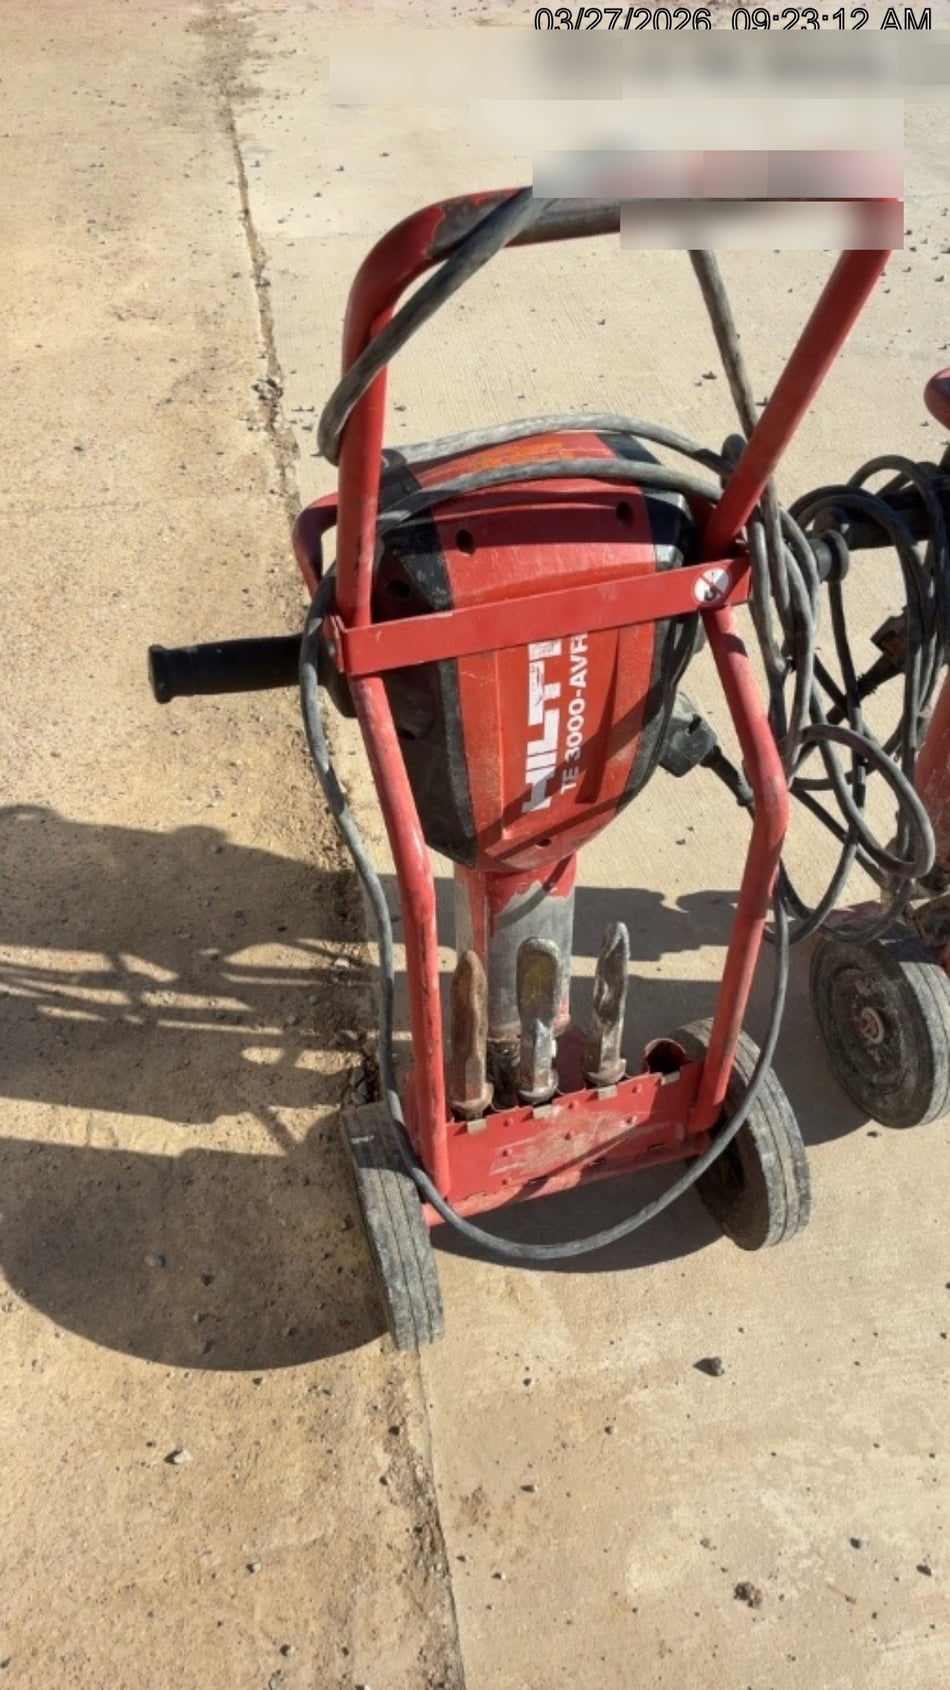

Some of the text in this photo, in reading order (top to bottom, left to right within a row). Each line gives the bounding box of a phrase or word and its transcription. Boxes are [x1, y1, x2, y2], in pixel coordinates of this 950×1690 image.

[521, 638, 562, 813] HILTI
[560, 633, 589, 795] TE 3000-AVR
